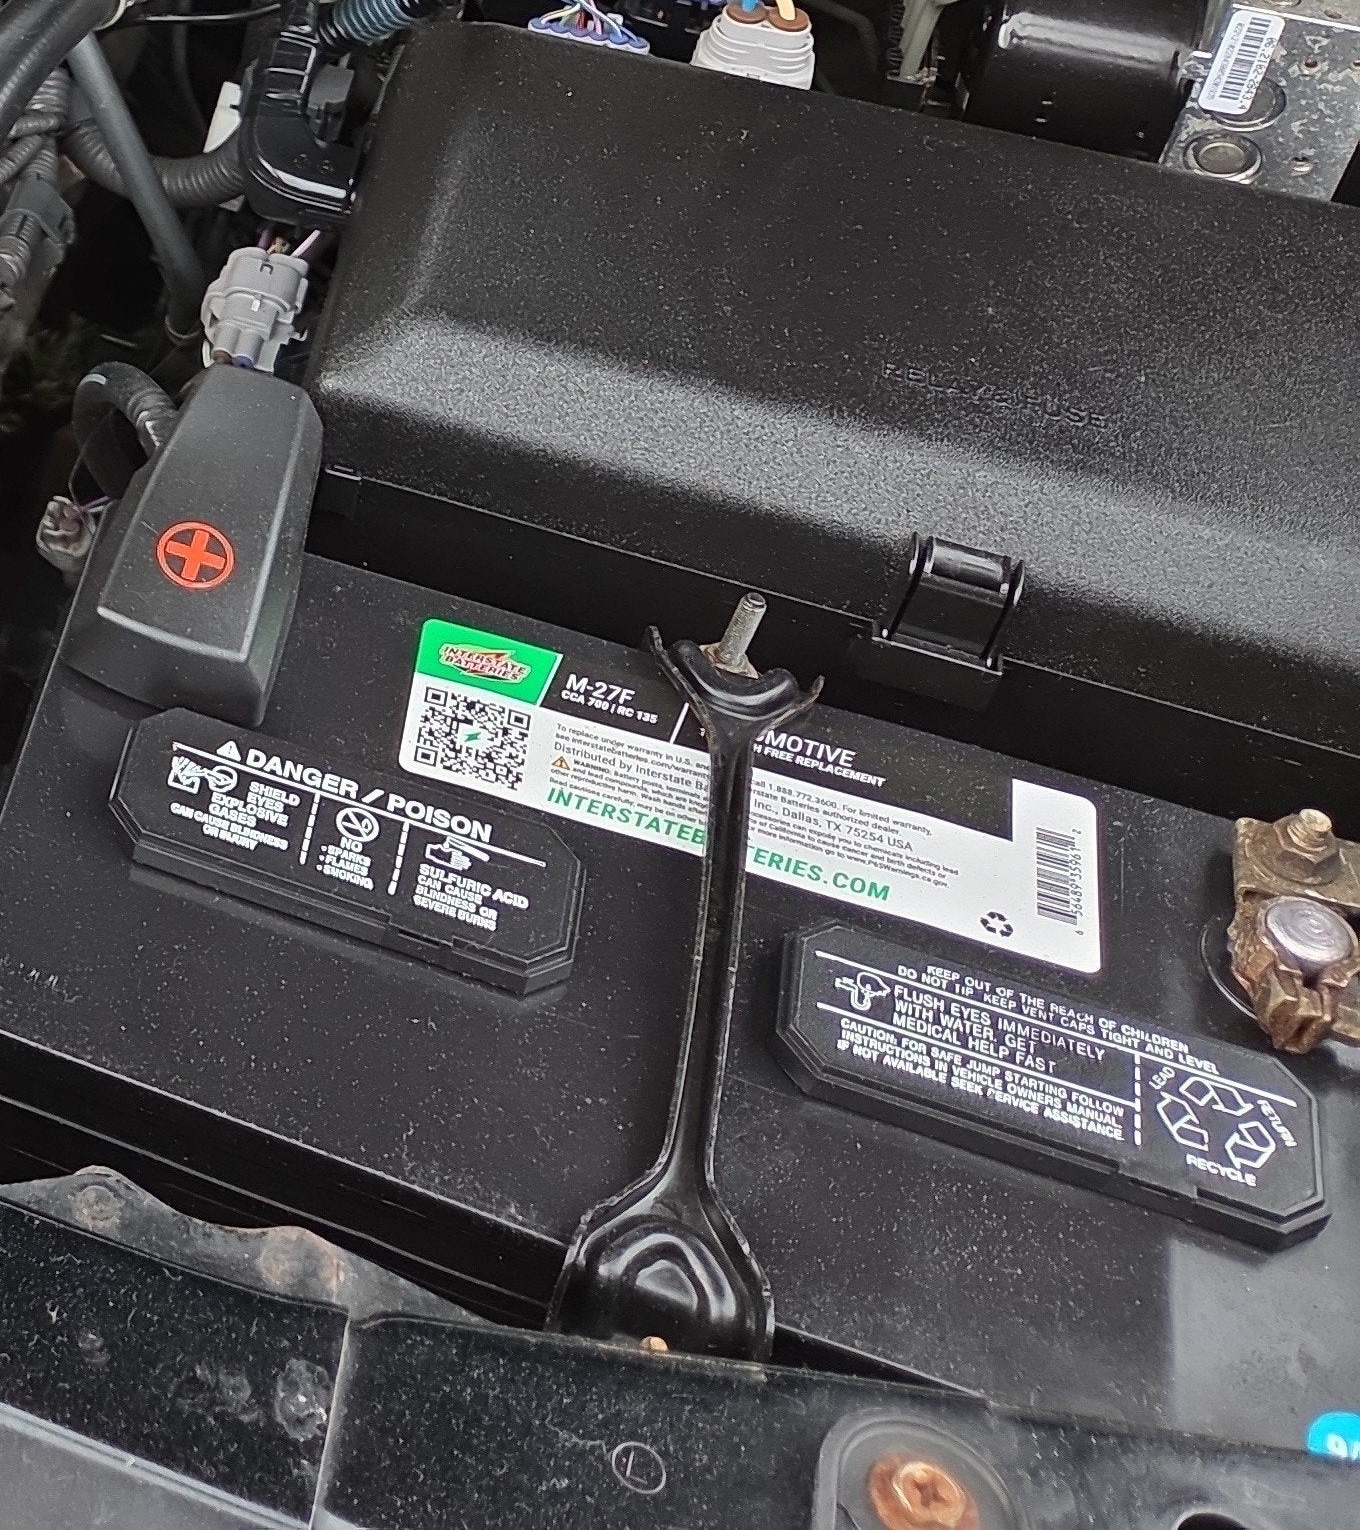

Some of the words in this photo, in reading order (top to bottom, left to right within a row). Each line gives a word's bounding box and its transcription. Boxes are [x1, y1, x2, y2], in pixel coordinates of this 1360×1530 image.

[444, 646, 527, 674] INTERSTATE
[445, 655, 518, 680] BATTERIES
[566, 674, 636, 705] M-27F
[561, 690, 585, 704] CCA
[588, 697, 610, 711] 700
[617, 705, 635, 717] RC
[636, 710, 658, 724] 135
[557, 723, 566, 731] To
[569, 728, 599, 741] replace
[601, 736, 625, 747] under
[627, 744, 663, 759] warranty
[842, 804, 857, 814] For
[858, 809, 890, 823] limited
[763, 748, 795, 763] FREE
[794, 756, 886, 788] REPLACEMENT
[170, 802, 194, 819] CAN
[211, 792, 289, 827] EXPLOSIVE
[246, 748, 359, 799] DANGER
[386, 793, 493, 843] POISON
[246, 792, 284, 813] EYES
[249, 781, 301, 807] SHIELD
[554, 742, 616, 766] Distributed
[619, 758, 632, 772] by
[636, 764, 692, 786] Interstate
[782, 807, 822, 828] Dallas,
[825, 820, 842, 833] TX
[845, 825, 884, 844] 75254
[887, 837, 914, 852] USA
[208, 803, 257, 828] GASES
[781, 796, 820, 813] Batteries
[822, 810, 870, 828] authorized
[202, 824, 219, 837] OR
[340, 836, 363, 853] NO
[325, 855, 369, 876] FLAMES
[328, 844, 372, 866] SPARKS
[323, 864, 374, 891] SMOKING
[417, 874, 441, 890] CAN
[444, 883, 483, 905] CAUSE
[419, 863, 492, 898] SULFURIC
[492, 888, 529, 910] ACID
[413, 895, 456, 918] SEVERE
[457, 909, 497, 932] BURNS
[415, 884, 476, 913] BLINDNESS
[479, 906, 498, 919] OR
[893, 984, 945, 1012] FLUSH
[950, 1003, 992, 1024] EYES
[997, 1017, 1105, 1062] IMMEDIATELY
[894, 999, 933, 1022] WITH
[1004, 1033, 1036, 1054] GET
[897, 964, 917, 980] DO
[921, 973, 948, 990] NOT
[954, 983, 974, 997] TIP
[983, 993, 1017, 1011] KEEP
[1021, 1004, 1055, 1022] VENT
[1060, 1016, 1096, 1036] CAPS
[1100, 1028, 1141, 1049] TIGHT
[1144, 1043, 1174, 1060] AND
[1179, 1052, 1220, 1075] LEVEL
[926, 965, 960, 982] KEEP
[965, 976, 992, 993] OUT
[995, 987, 1014, 1000] OF
[1019, 992, 1045, 1010] THE
[1050, 1002, 1094, 1024] REACH
[1098, 1017, 1117, 1031] OF
[1120, 1024, 1189, 1054] CHILDREN
[892, 1013, 962, 1045] MEDICAL
[967, 1036, 1009, 1059] HELP
[1015, 1051, 1057, 1074] FAST
[837, 1039, 850, 1051] IF
[852, 1044, 880, 1063] NOT
[883, 1055, 947, 1084] AVAILABLE
[950, 1076, 983, 1096] SEEK
[840, 1018, 898, 1044] CAUTION:
[901, 1037, 927, 1053] FOR
[930, 1046, 963, 1065] SAFE
[966, 1058, 1000, 1077] JUMP
[1004, 1070, 1068, 1099] STARTING
[1071, 1092, 1124, 1117] FOLLOW
[841, 1030, 930, 1066] INSTRUCTIONS
[934, 1059, 948, 1072] IN
[952, 1064, 1003, 1090] VEHICLE
[1007, 1083, 1062, 1109] OWNERS
[1148, 1066, 1176, 1090] LEAD
[1186, 1153, 1257, 1187] RECYCLE
